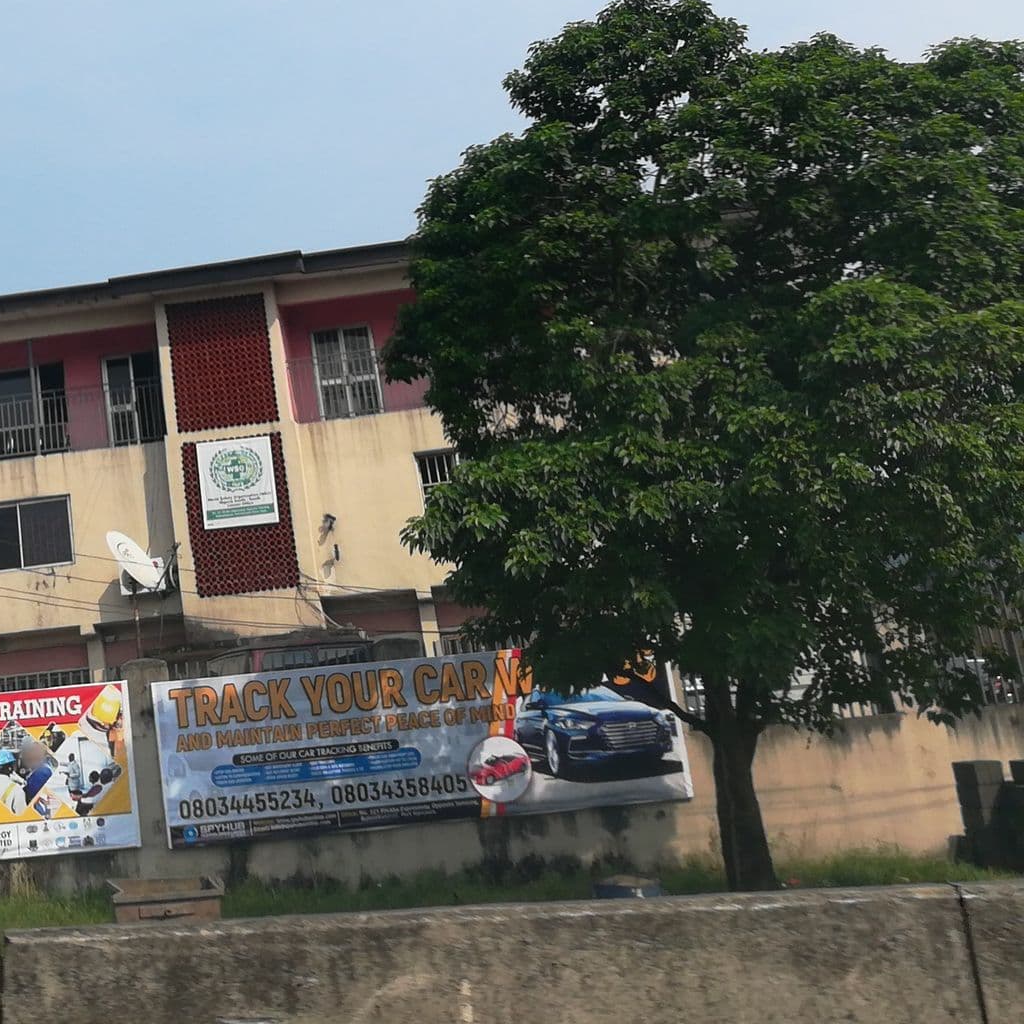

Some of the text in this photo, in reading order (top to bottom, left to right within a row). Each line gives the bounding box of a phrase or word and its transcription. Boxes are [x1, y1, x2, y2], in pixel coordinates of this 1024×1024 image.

[168, 678, 295, 727] TRACK
[300, 668, 406, 715] YOUR
[412, 660, 492, 704] CAR
[176, 702, 517, 752] AND MAINTAIN PERFECT PEACE OF MIND
[239, 740, 393, 763] SOME OF OUR CAR TRACKING BENEFITS
[179, 773, 467, 818] 08034455234, 08034358405
